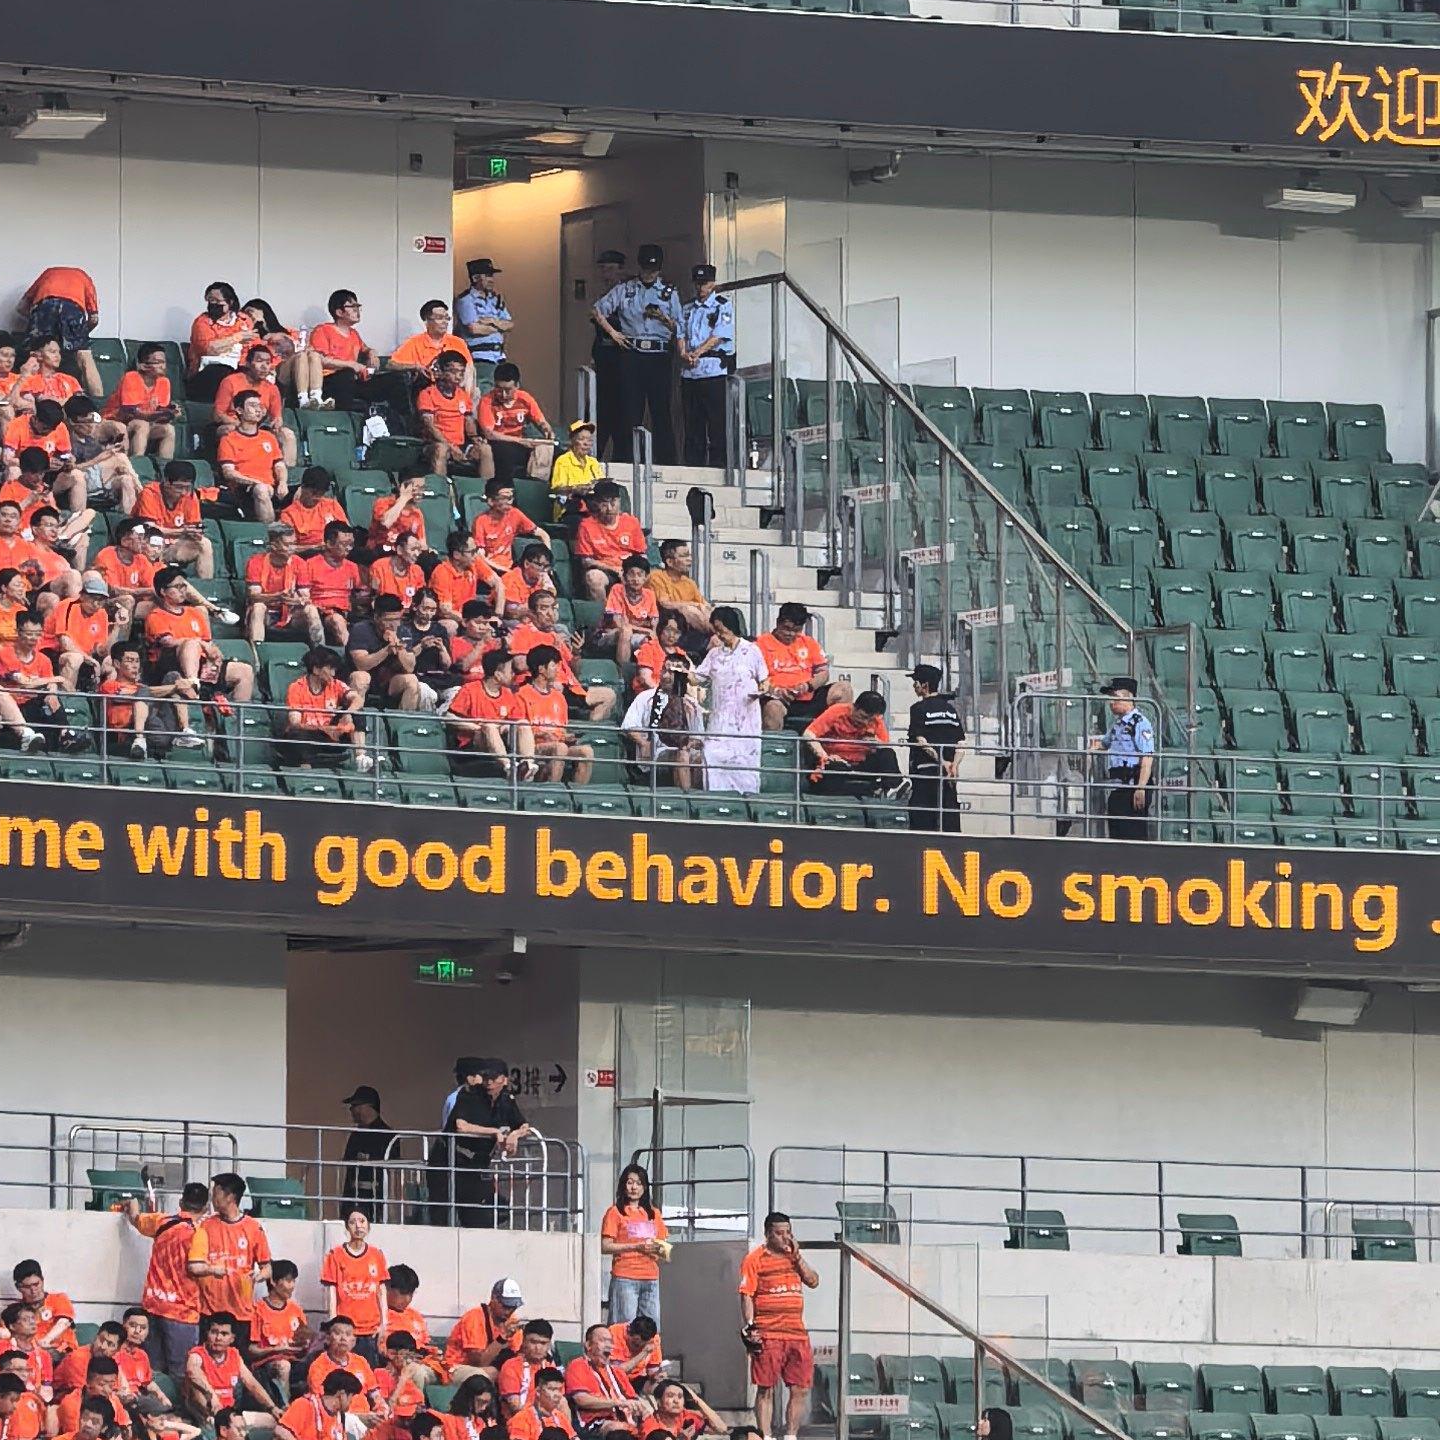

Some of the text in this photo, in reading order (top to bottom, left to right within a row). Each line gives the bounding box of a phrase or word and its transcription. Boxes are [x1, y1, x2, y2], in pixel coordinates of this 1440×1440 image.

[1297, 63, 1440, 146] 欢迎
[126, 808, 286, 882] with
[313, 825, 505, 905] good
[535, 827, 888, 912] behavior.
[923, 850, 1032, 918] No
[1062, 860, 1397, 952] smoking
